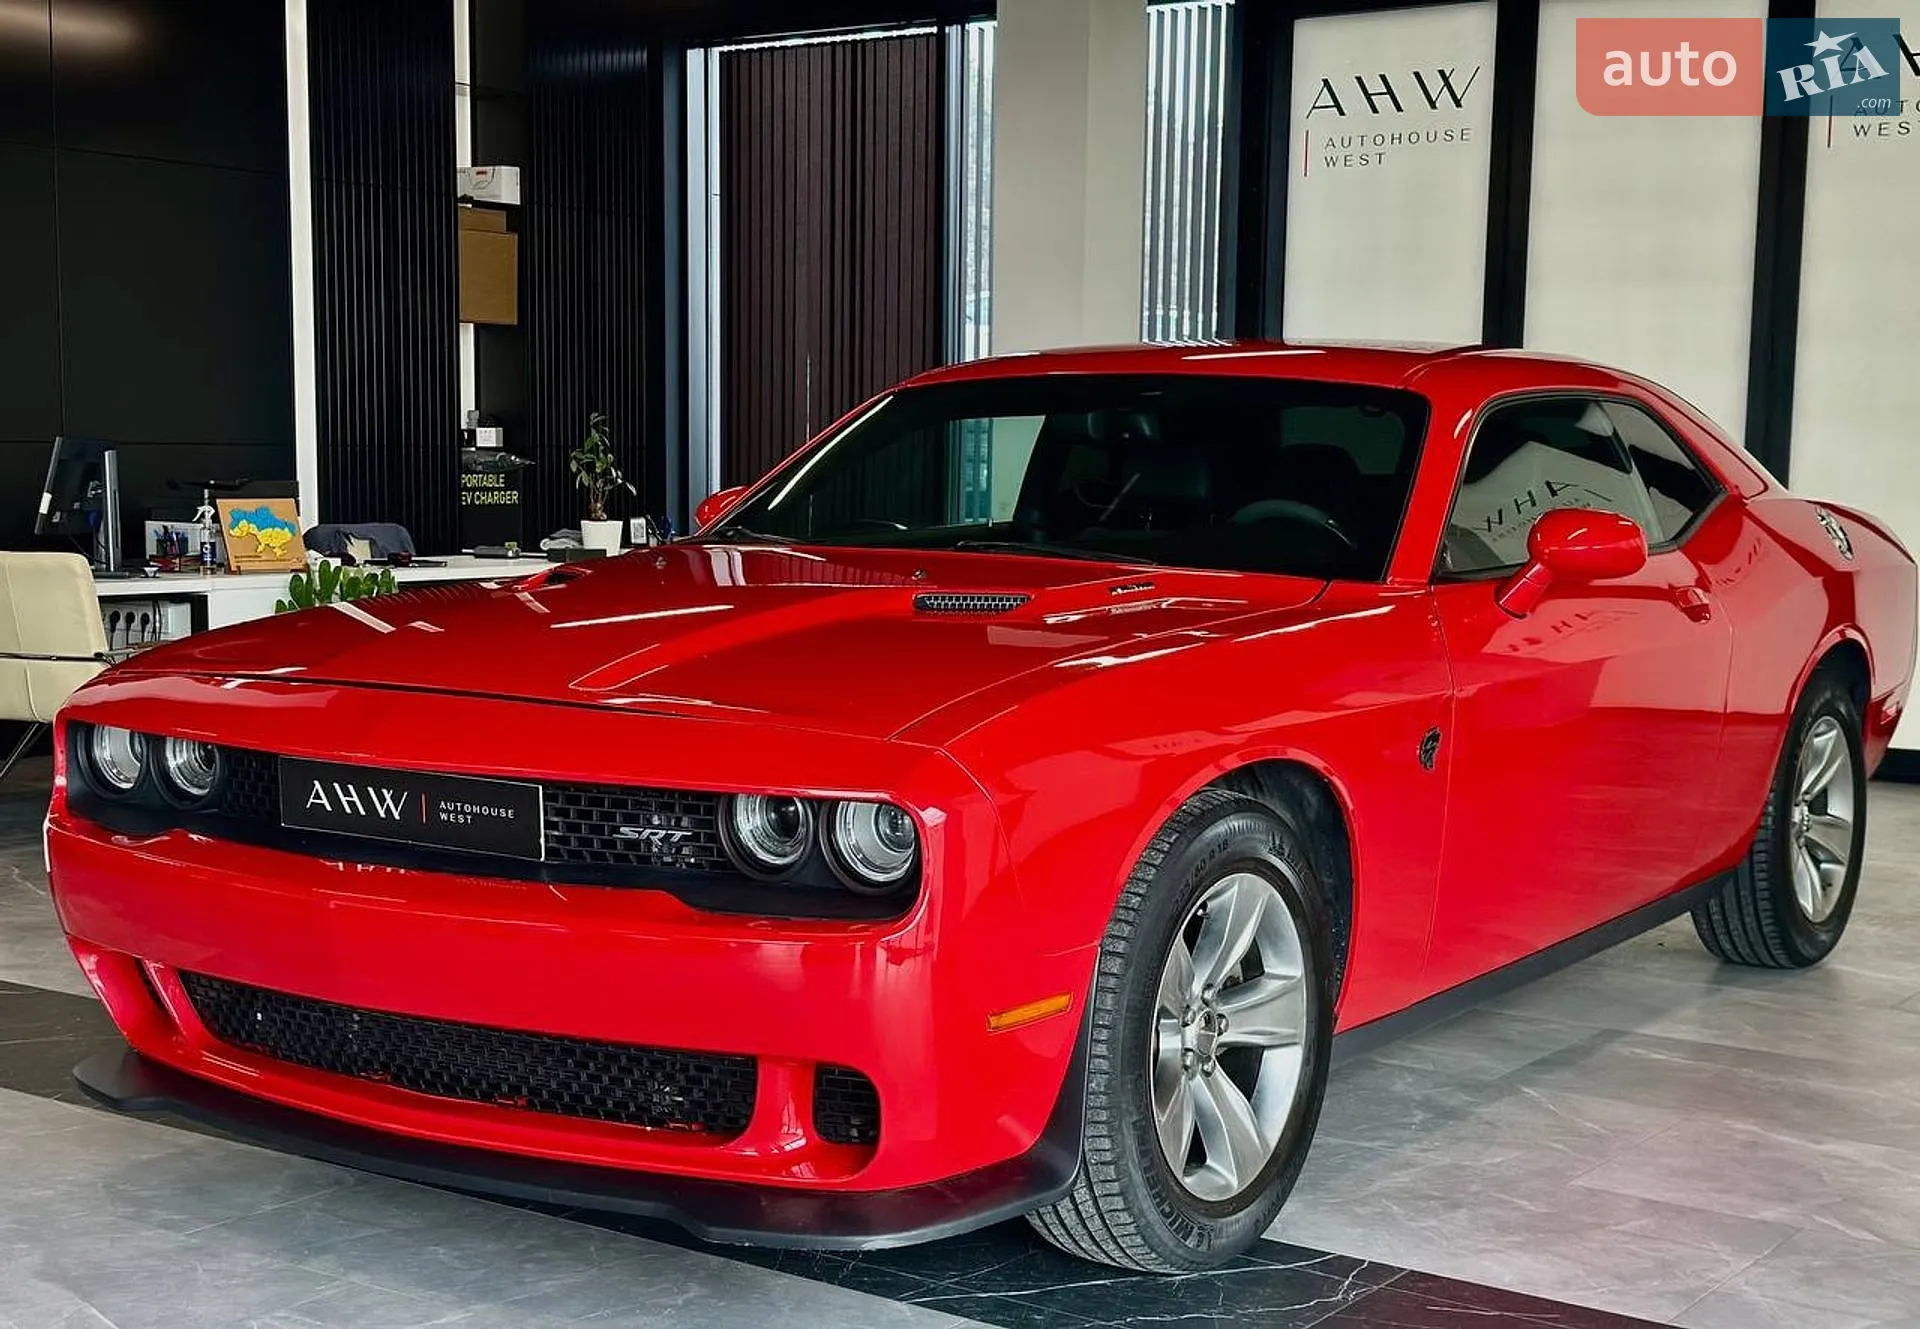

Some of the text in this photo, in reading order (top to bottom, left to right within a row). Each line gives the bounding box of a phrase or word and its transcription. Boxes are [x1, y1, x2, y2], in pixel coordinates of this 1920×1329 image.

[1306, 66, 1481, 119] AHW
[1853, 121, 1920, 137] WES
[1325, 128, 1473, 149] AUTOHOUSE
[1325, 152, 1386, 168] WEST
[461, 474, 505, 487] PORTABLE
[474, 490, 519, 505] CHARGER
[306, 780, 408, 820] AHW
[439, 801, 515, 819] AUTOHOUSE
[439, 811, 473, 824] WEST
[612, 827, 693, 846] SRT
